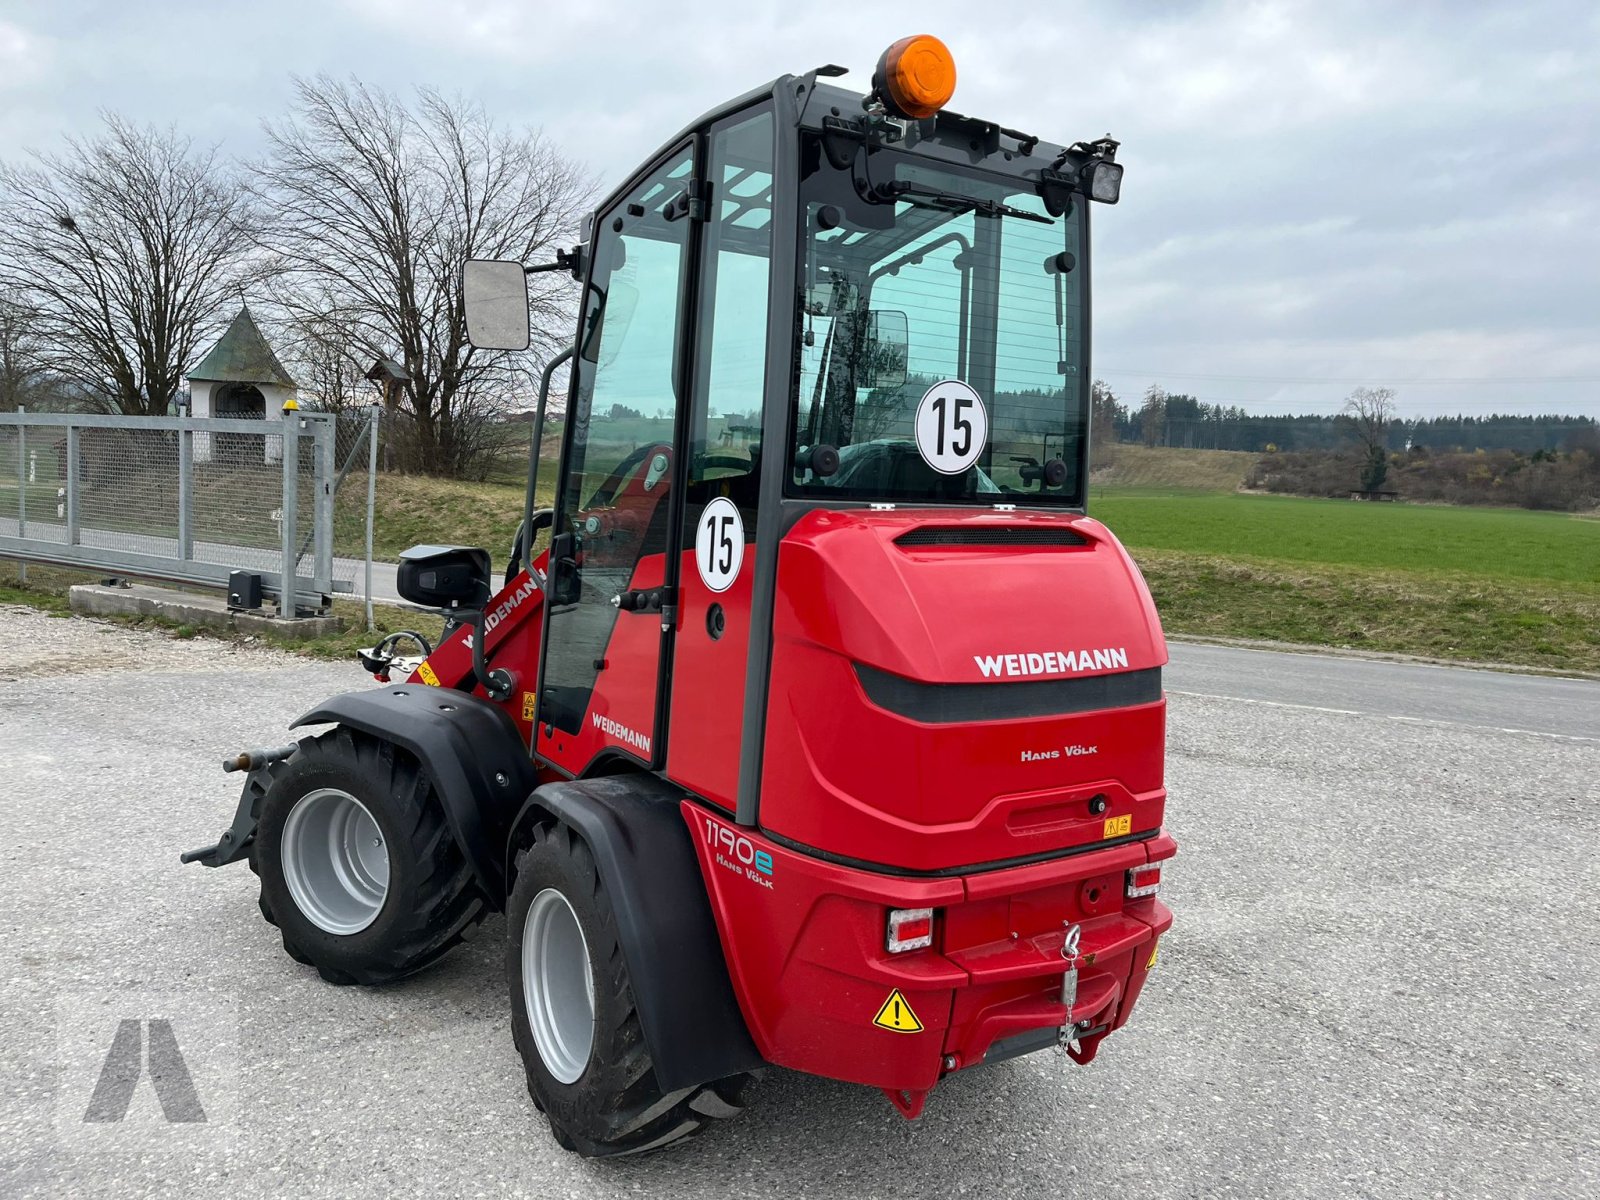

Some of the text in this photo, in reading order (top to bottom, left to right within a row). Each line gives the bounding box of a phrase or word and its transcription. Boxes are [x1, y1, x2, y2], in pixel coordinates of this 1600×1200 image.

[932, 397, 973, 457] 15
[707, 515, 734, 575] 15
[461, 567, 547, 649] WIDEMANN
[973, 647, 1129, 678] WEIDEMANN
[592, 711, 651, 752] WEIDEMANN
[706, 818, 773, 876] 1190e
